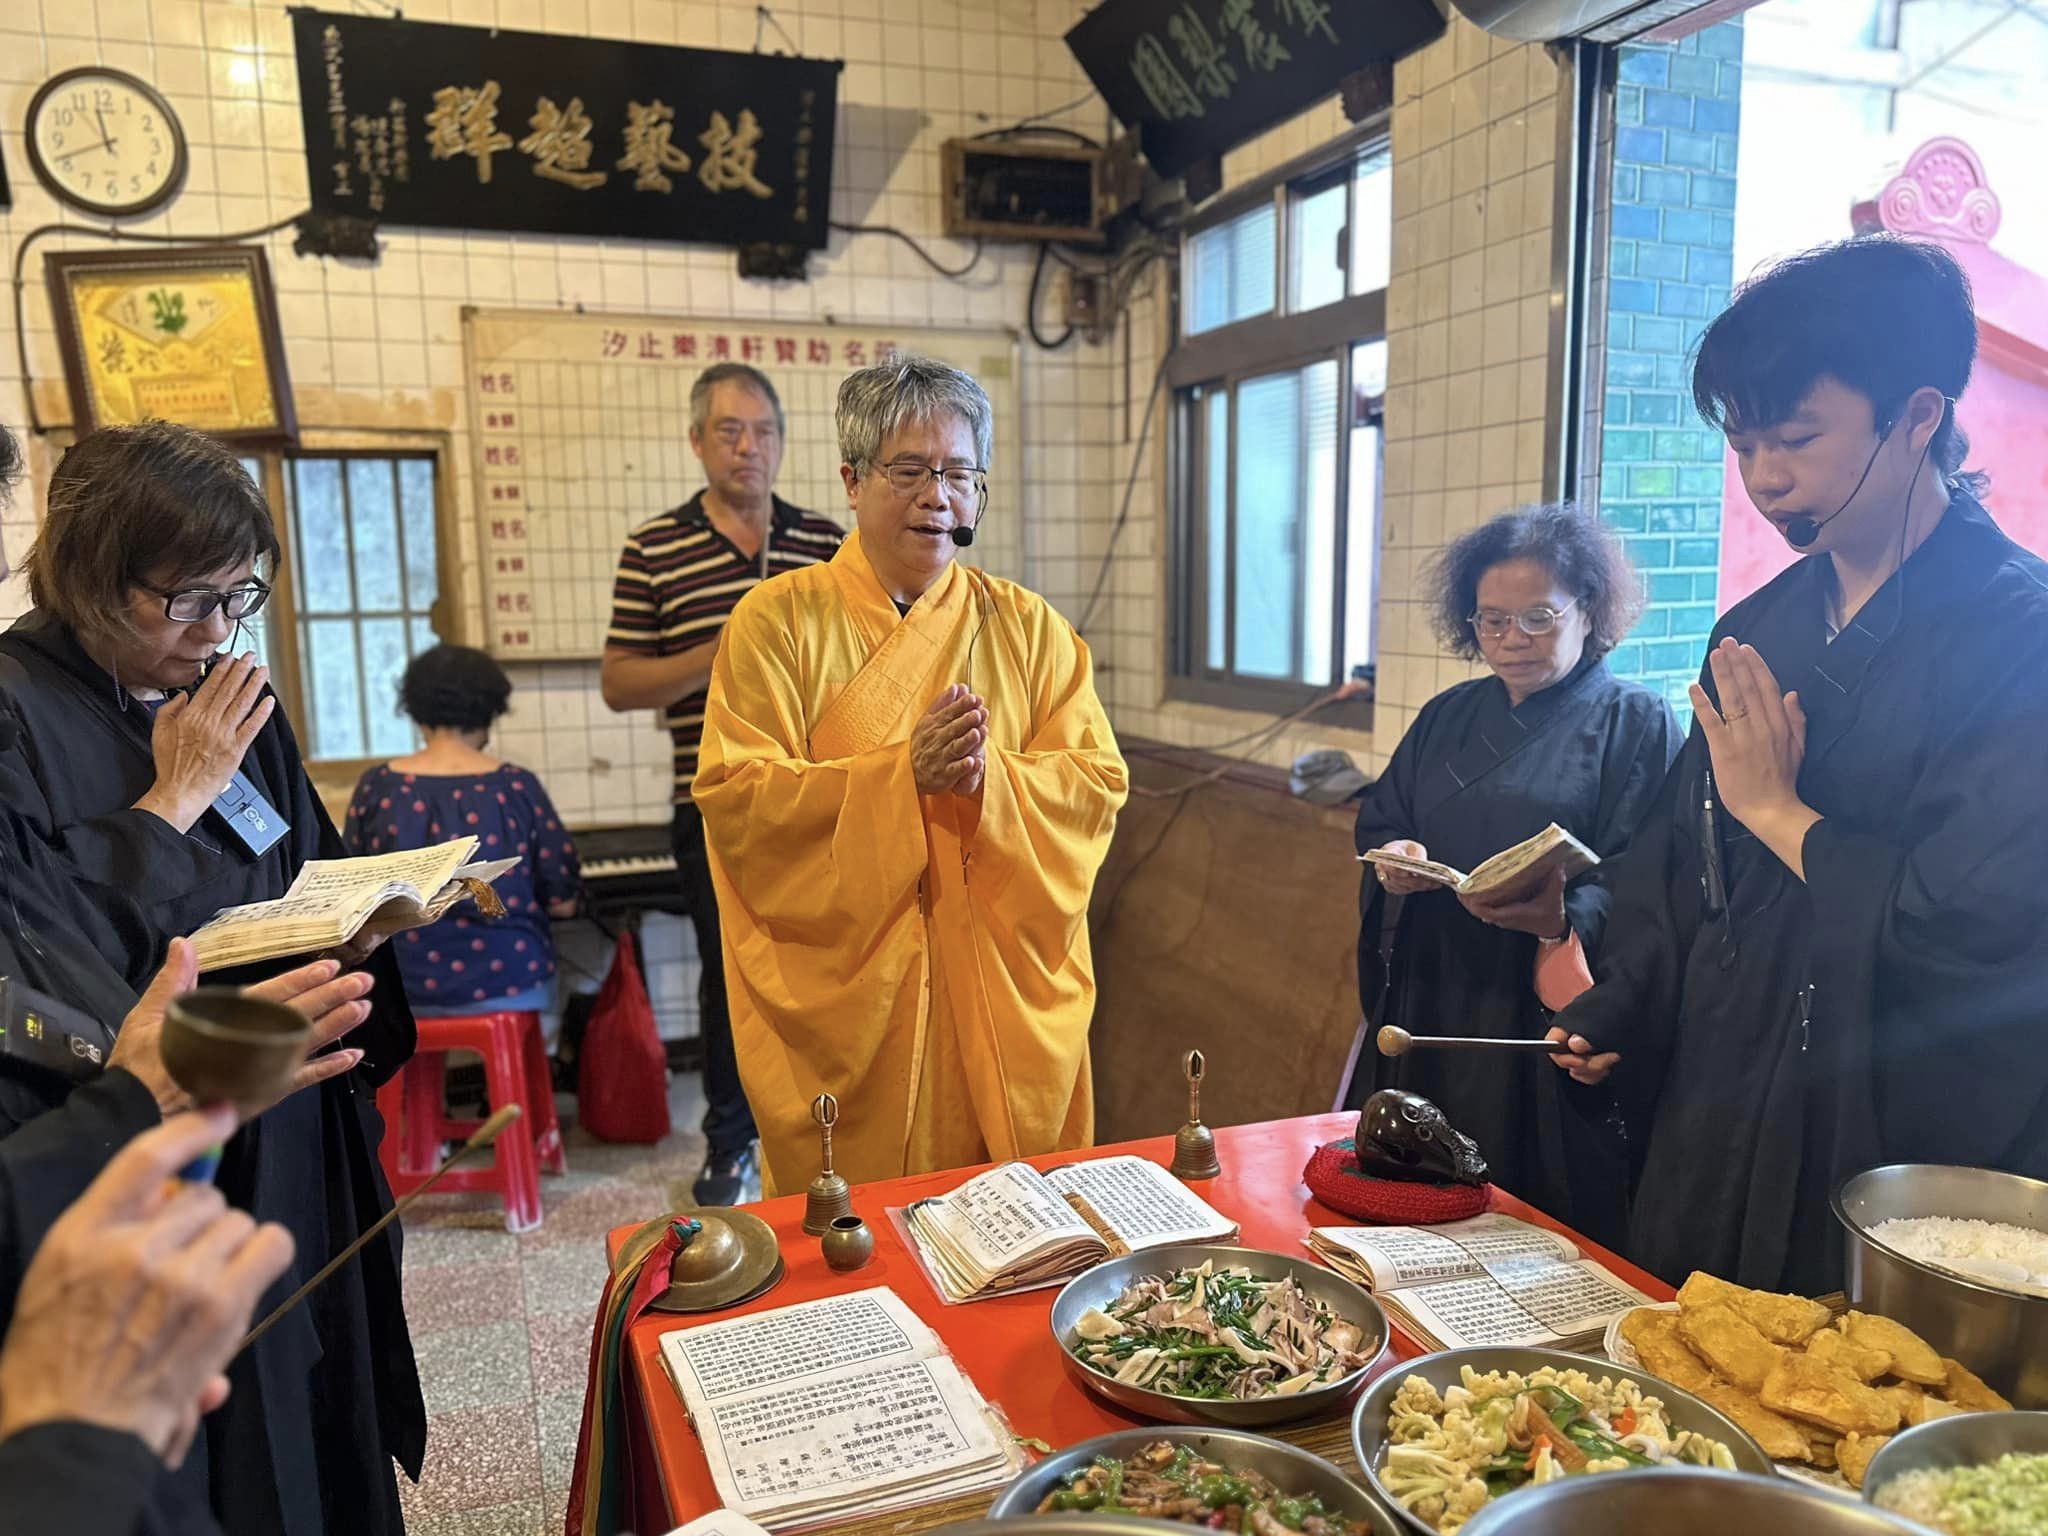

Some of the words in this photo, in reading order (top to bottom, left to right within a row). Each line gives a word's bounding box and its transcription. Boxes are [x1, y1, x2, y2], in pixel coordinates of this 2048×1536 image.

[72, 93, 87, 112] 11
[94, 89, 113, 108] 12
[124, 98, 132, 114] 1
[53, 108, 73, 127] 10
[142, 115, 152, 132] 2
[52, 130, 63, 148] 9
[151, 137, 161, 155] 3
[62, 157, 73, 172] 8
[146, 161, 157, 176] 4
[81, 172, 92, 189] 7
[106, 180, 118, 197] 6
[130, 175, 141, 192] 5
[481, 373, 514, 393] 姓名
[485, 445, 519, 466] 姓名
[491, 519, 526, 540] 姓名
[497, 592, 530, 613] 姓名
